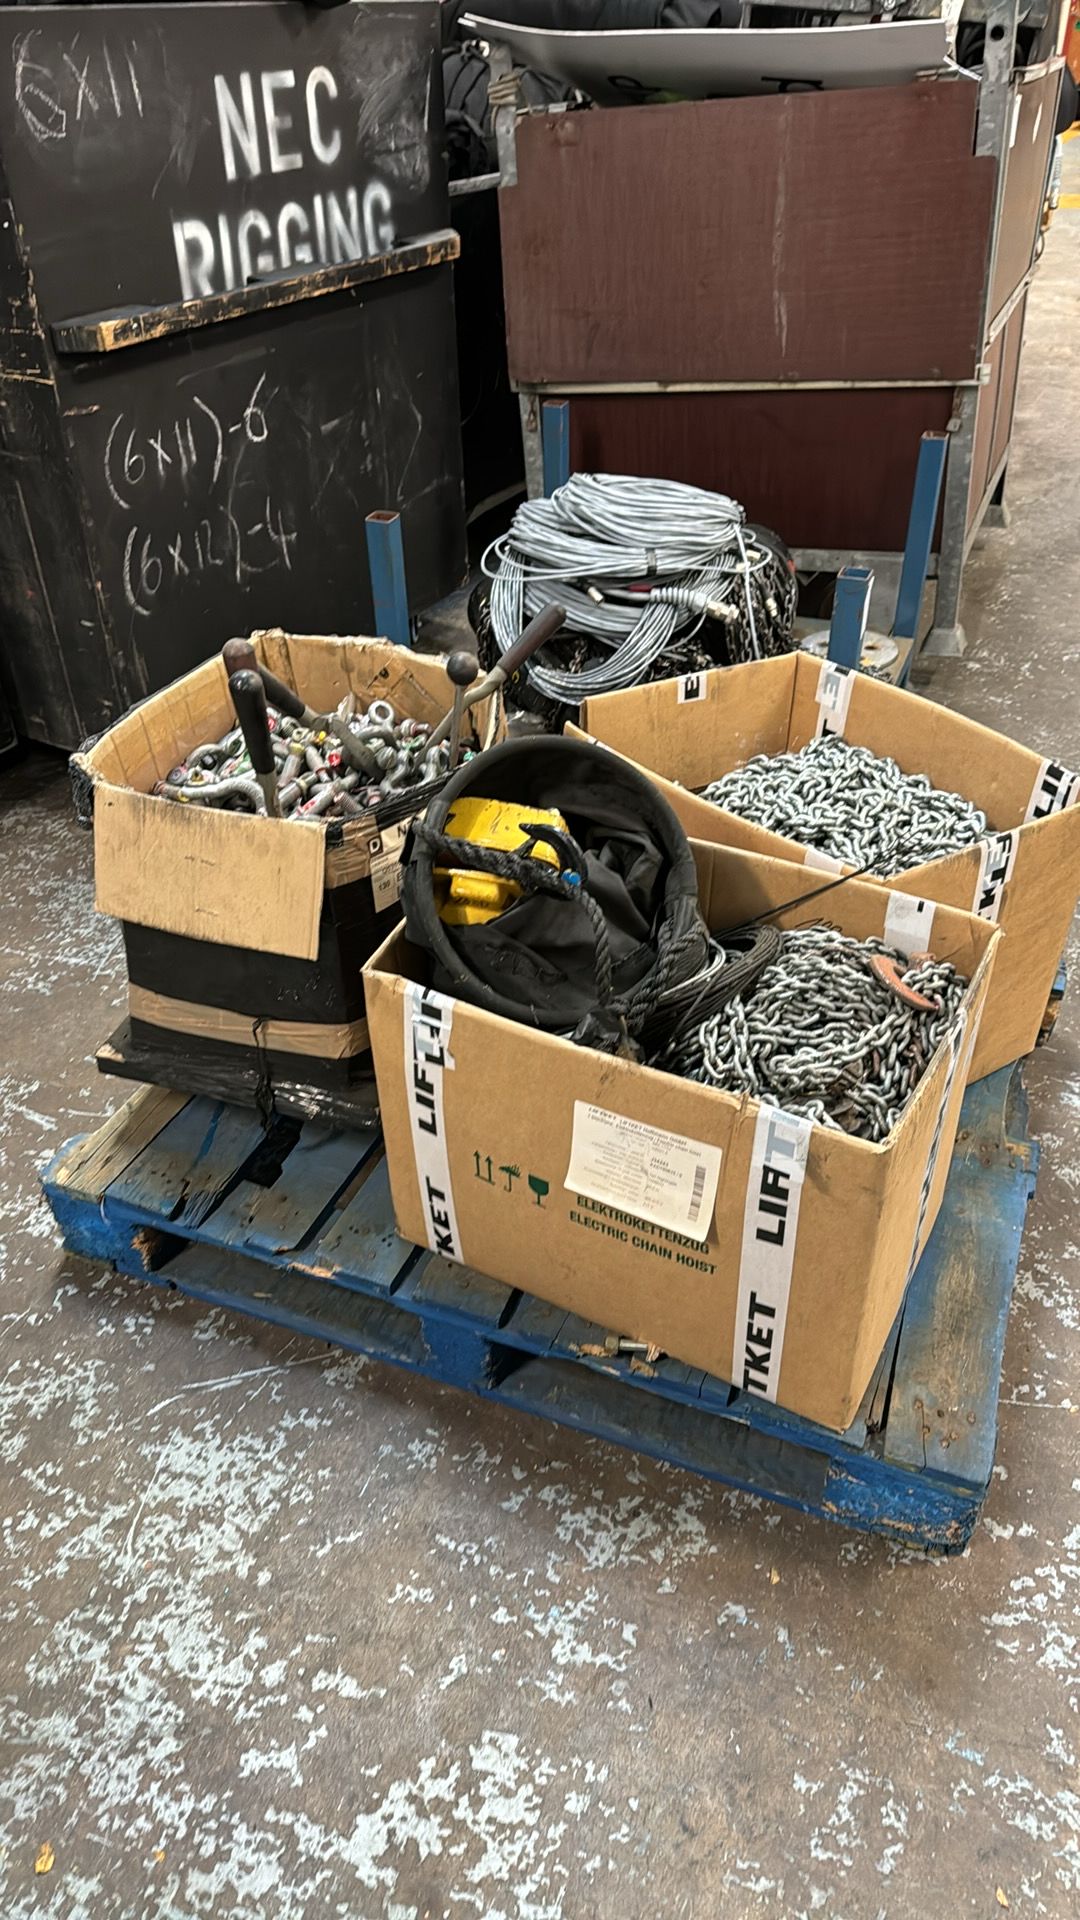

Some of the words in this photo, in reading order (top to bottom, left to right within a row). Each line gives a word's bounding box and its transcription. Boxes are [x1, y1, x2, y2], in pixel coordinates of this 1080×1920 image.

[213, 65, 342, 182] NEC
[172, 179, 396, 301] RIGGING
[426, 1175, 455, 1256] KET
[569, 1210, 629, 1242] ELECTRIC
[631, 1235, 673, 1260] CHAIN
[675, 1252, 718, 1276] HOIST
[742, 1290, 776, 1393] TKET
